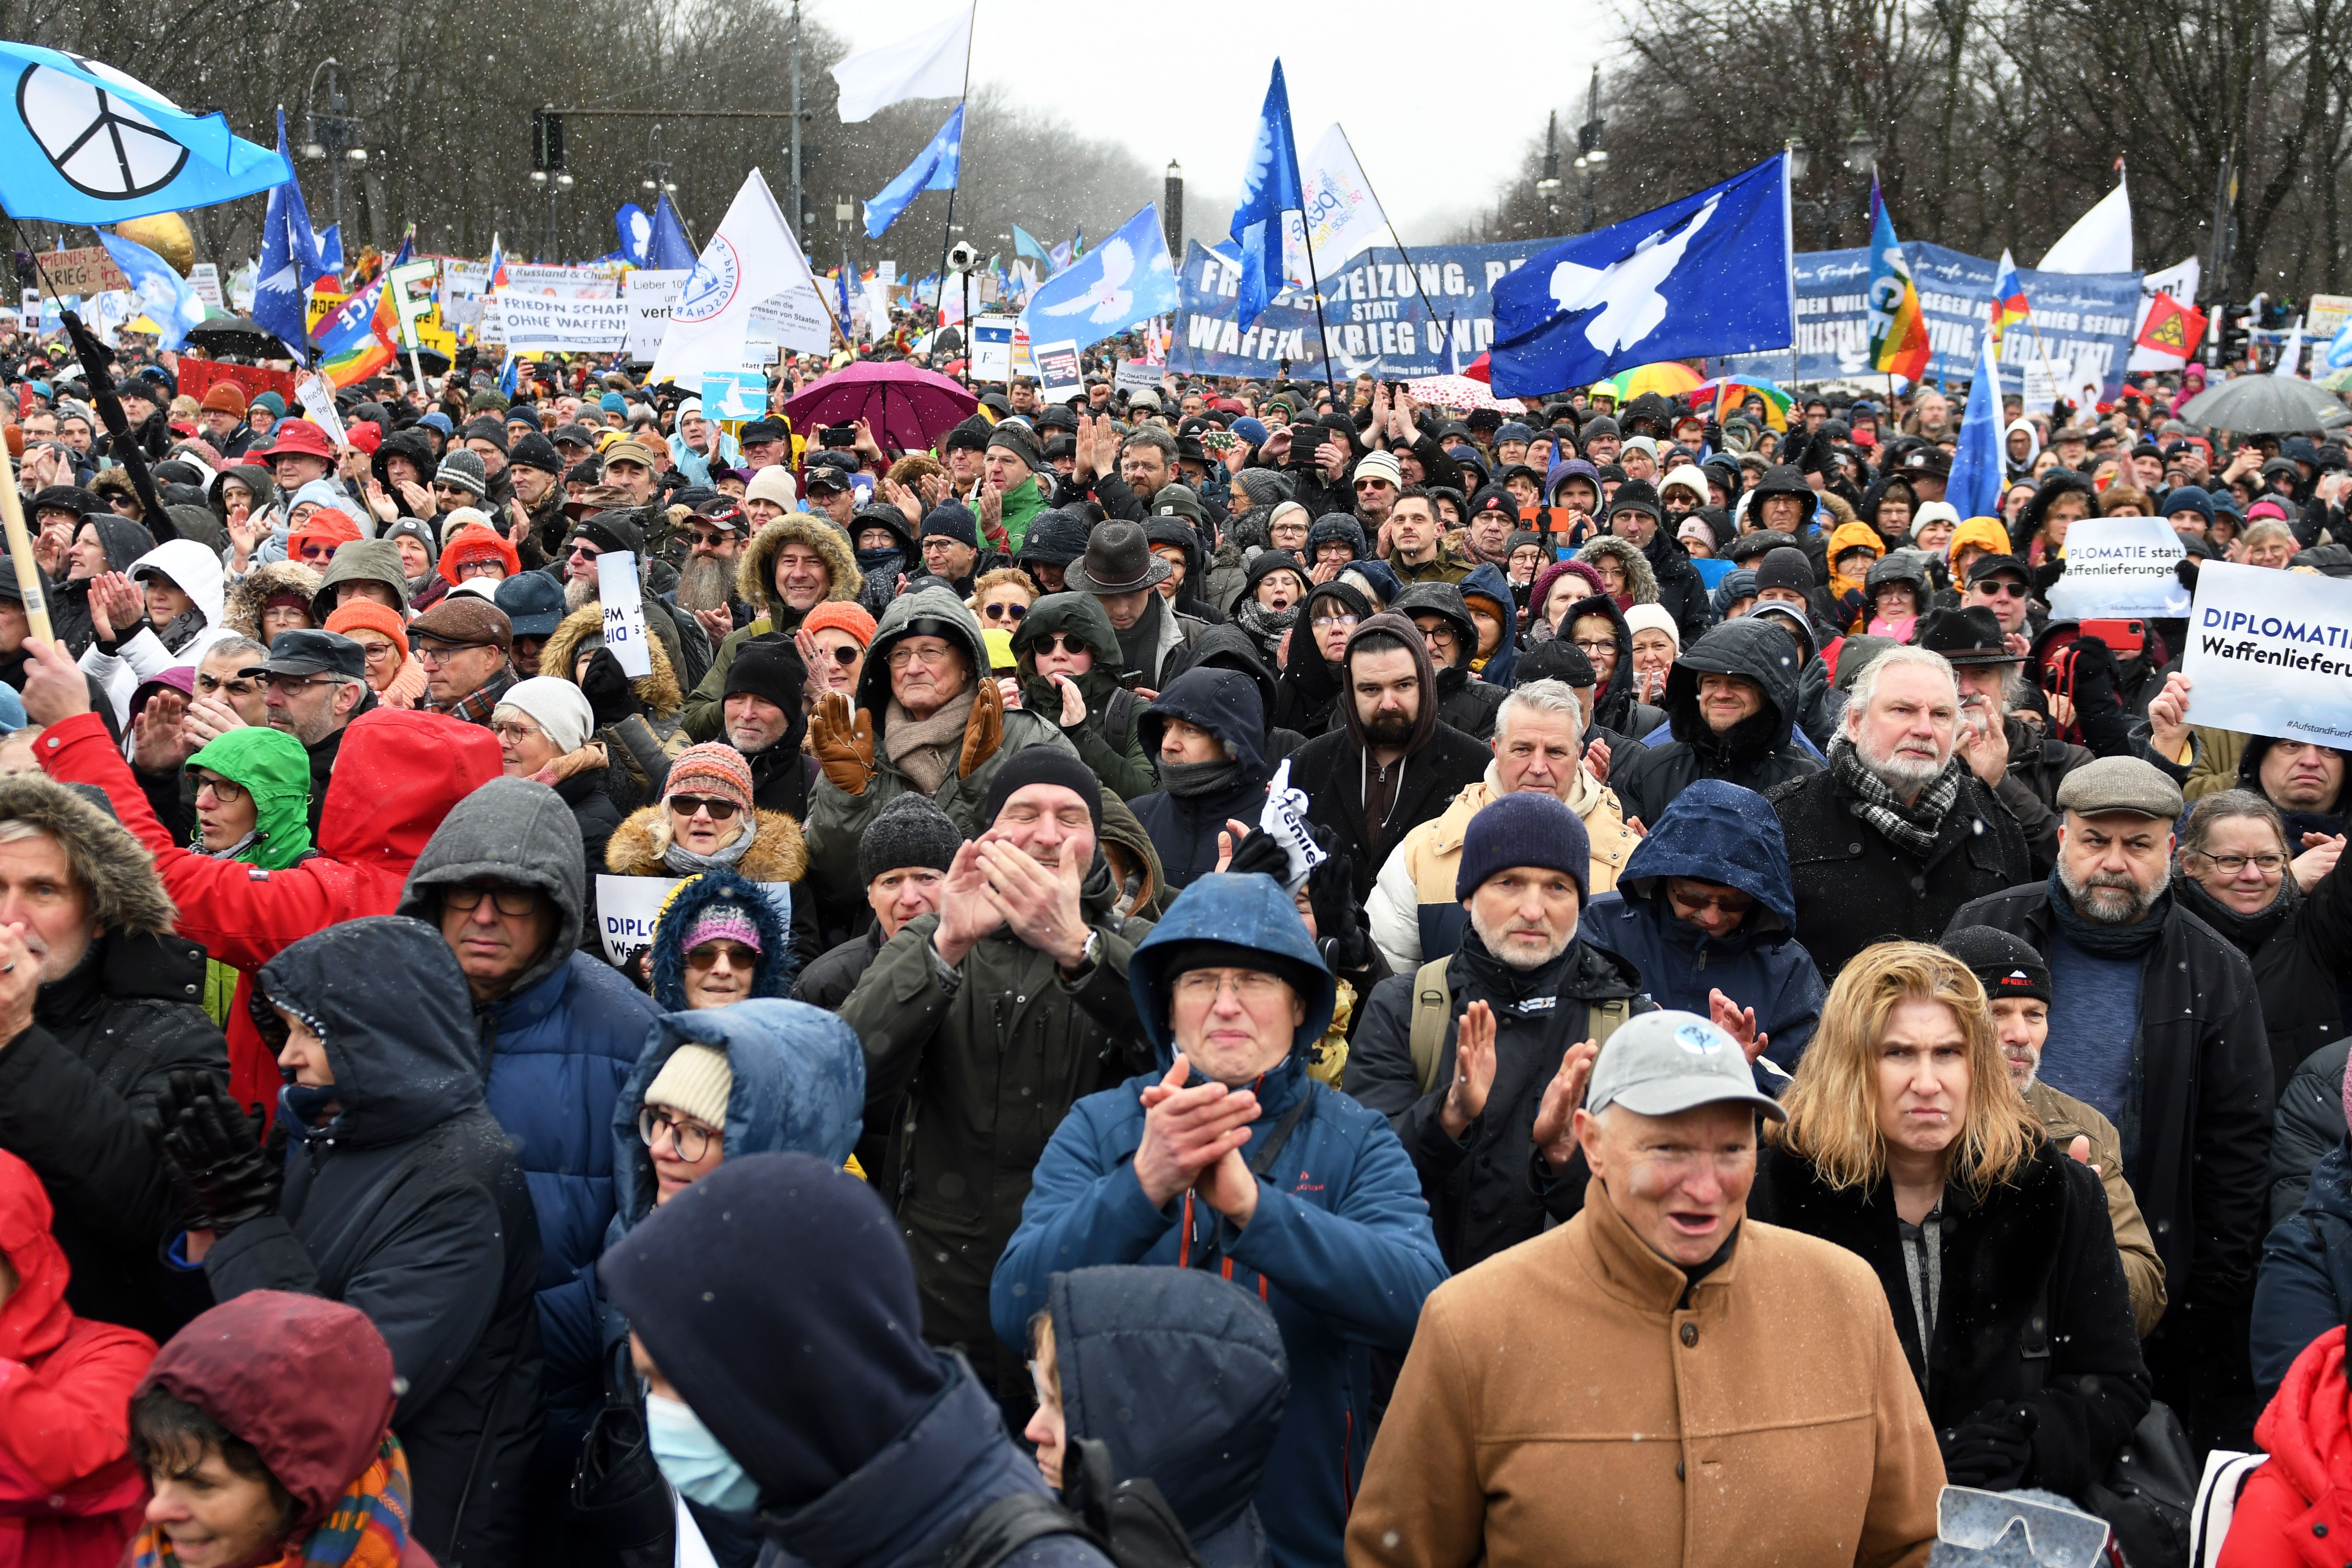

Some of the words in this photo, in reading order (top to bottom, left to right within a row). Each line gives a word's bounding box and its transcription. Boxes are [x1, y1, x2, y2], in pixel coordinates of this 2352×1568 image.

[40, 250, 87, 267] MEINEN
[634, 280, 666, 290] Lieber
[504, 297, 566, 313] FRIEDEN
[783, 301, 793, 310] die
[1351, 300, 1399, 322] STATT
[507, 314, 550, 327] OHNE
[556, 317, 626, 330] WAFFEN!
[780, 311, 792, 319] von
[794, 313, 822, 326] Staaten.
[2081, 313, 2131, 336] SEIN!
[1324, 321, 1415, 359] KRIEG
[1426, 318, 1494, 354] UND
[1117, 370, 1148, 381] DIPLOMATIE
[1117, 377, 1160, 388] Waffenlieferungen
[2151, 547, 2183, 558] statt
[2065, 563, 2176, 577] affenlieferunge
[2202, 607, 2352, 649] DIPLOMATI
